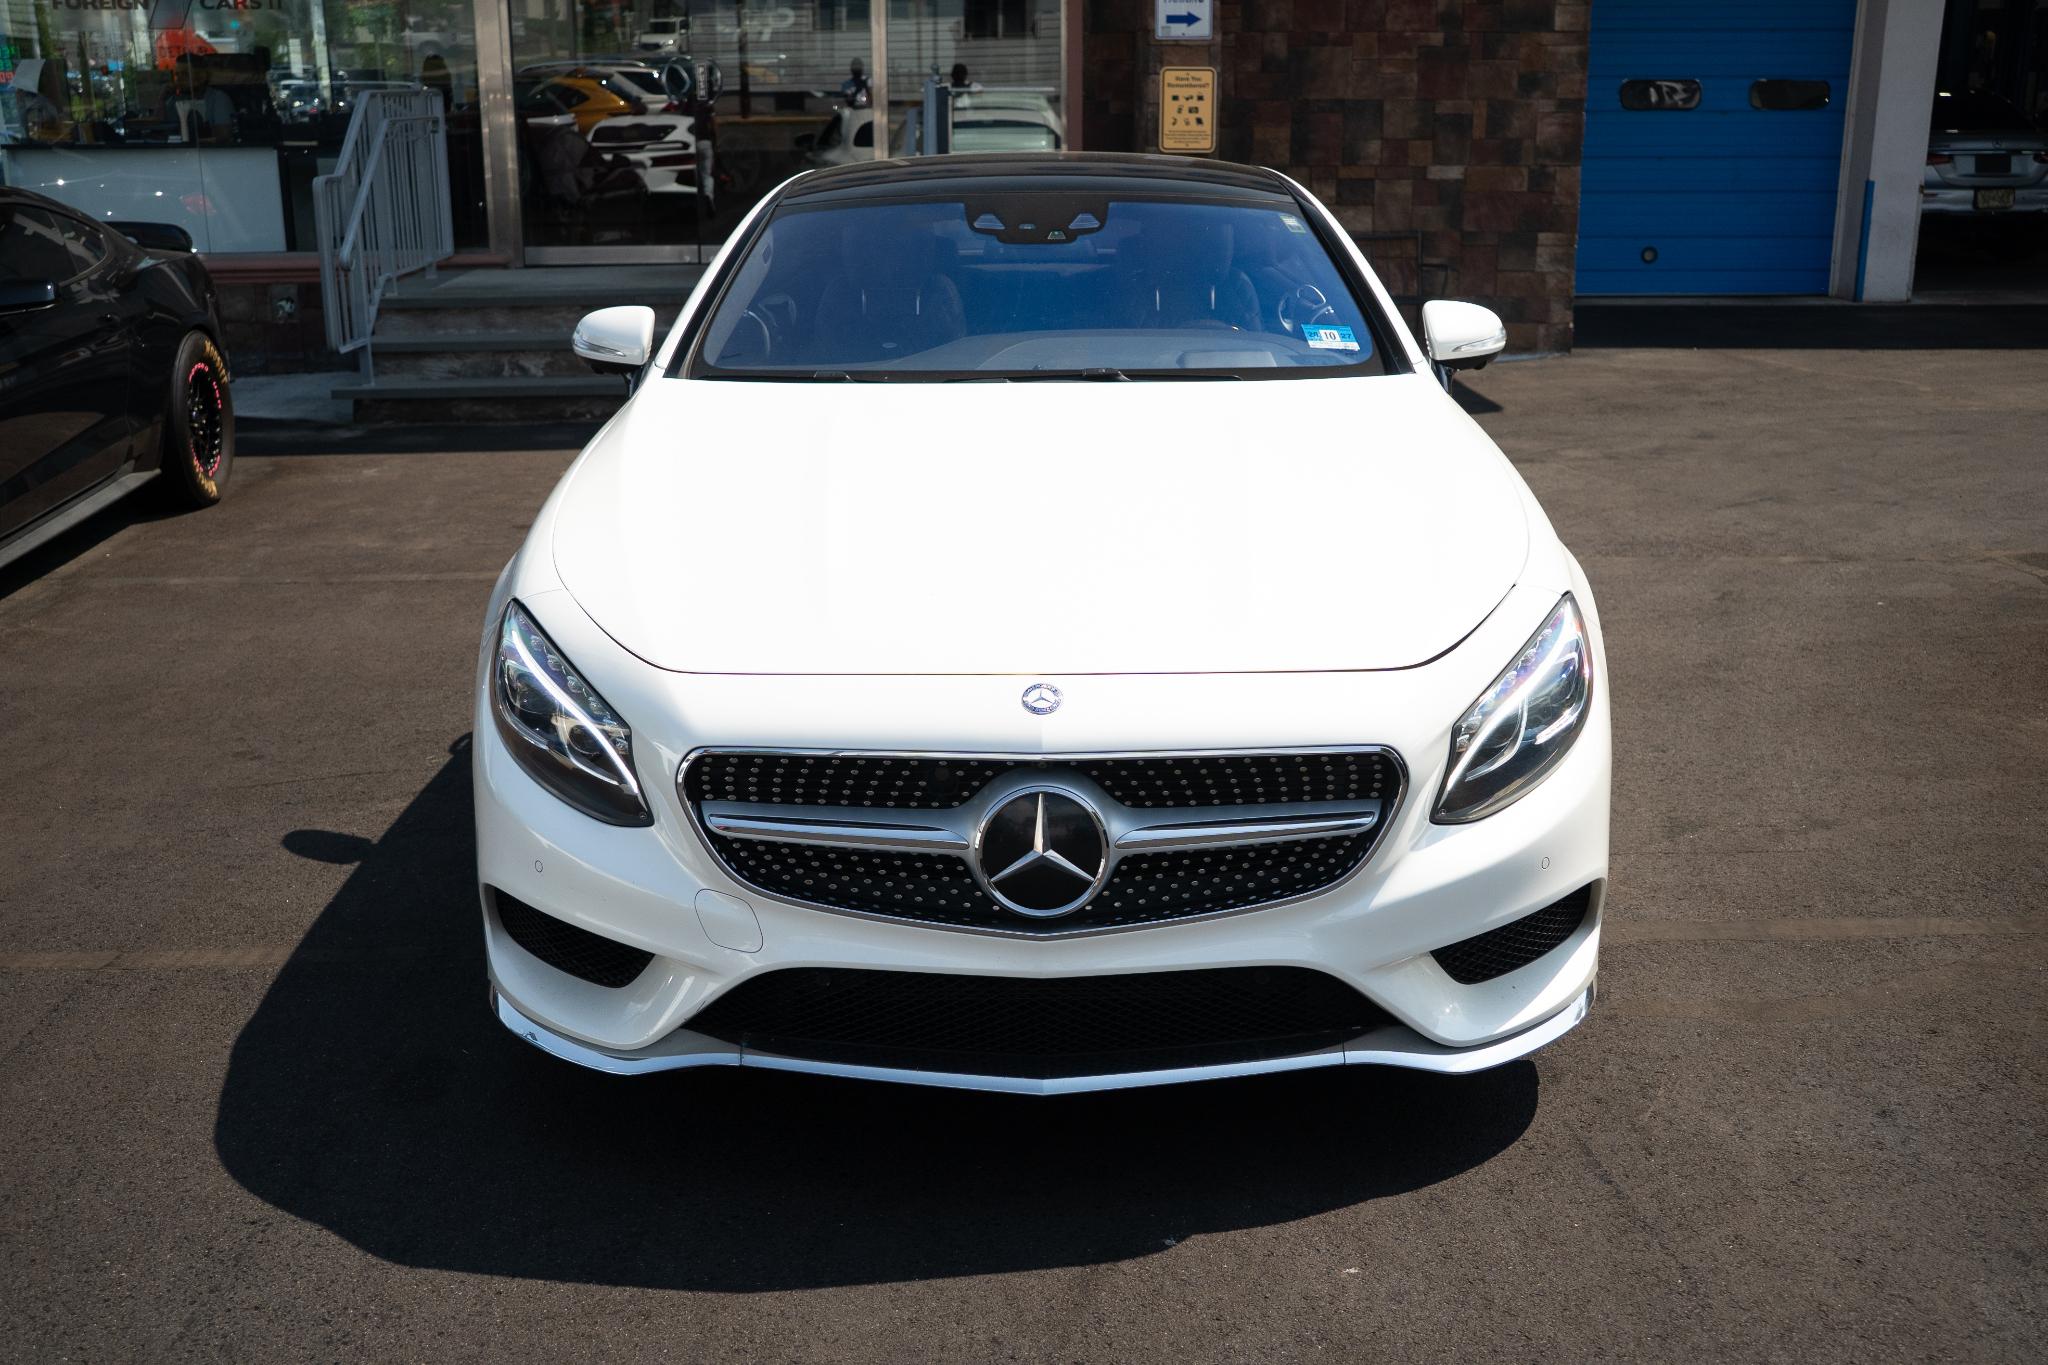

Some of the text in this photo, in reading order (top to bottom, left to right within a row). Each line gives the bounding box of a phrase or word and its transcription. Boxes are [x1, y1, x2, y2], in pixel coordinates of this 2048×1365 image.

[52, 0, 148, 10] FOREIGN
[201, 0, 263, 10] CARS
[1323, 331, 1337, 341] 10
